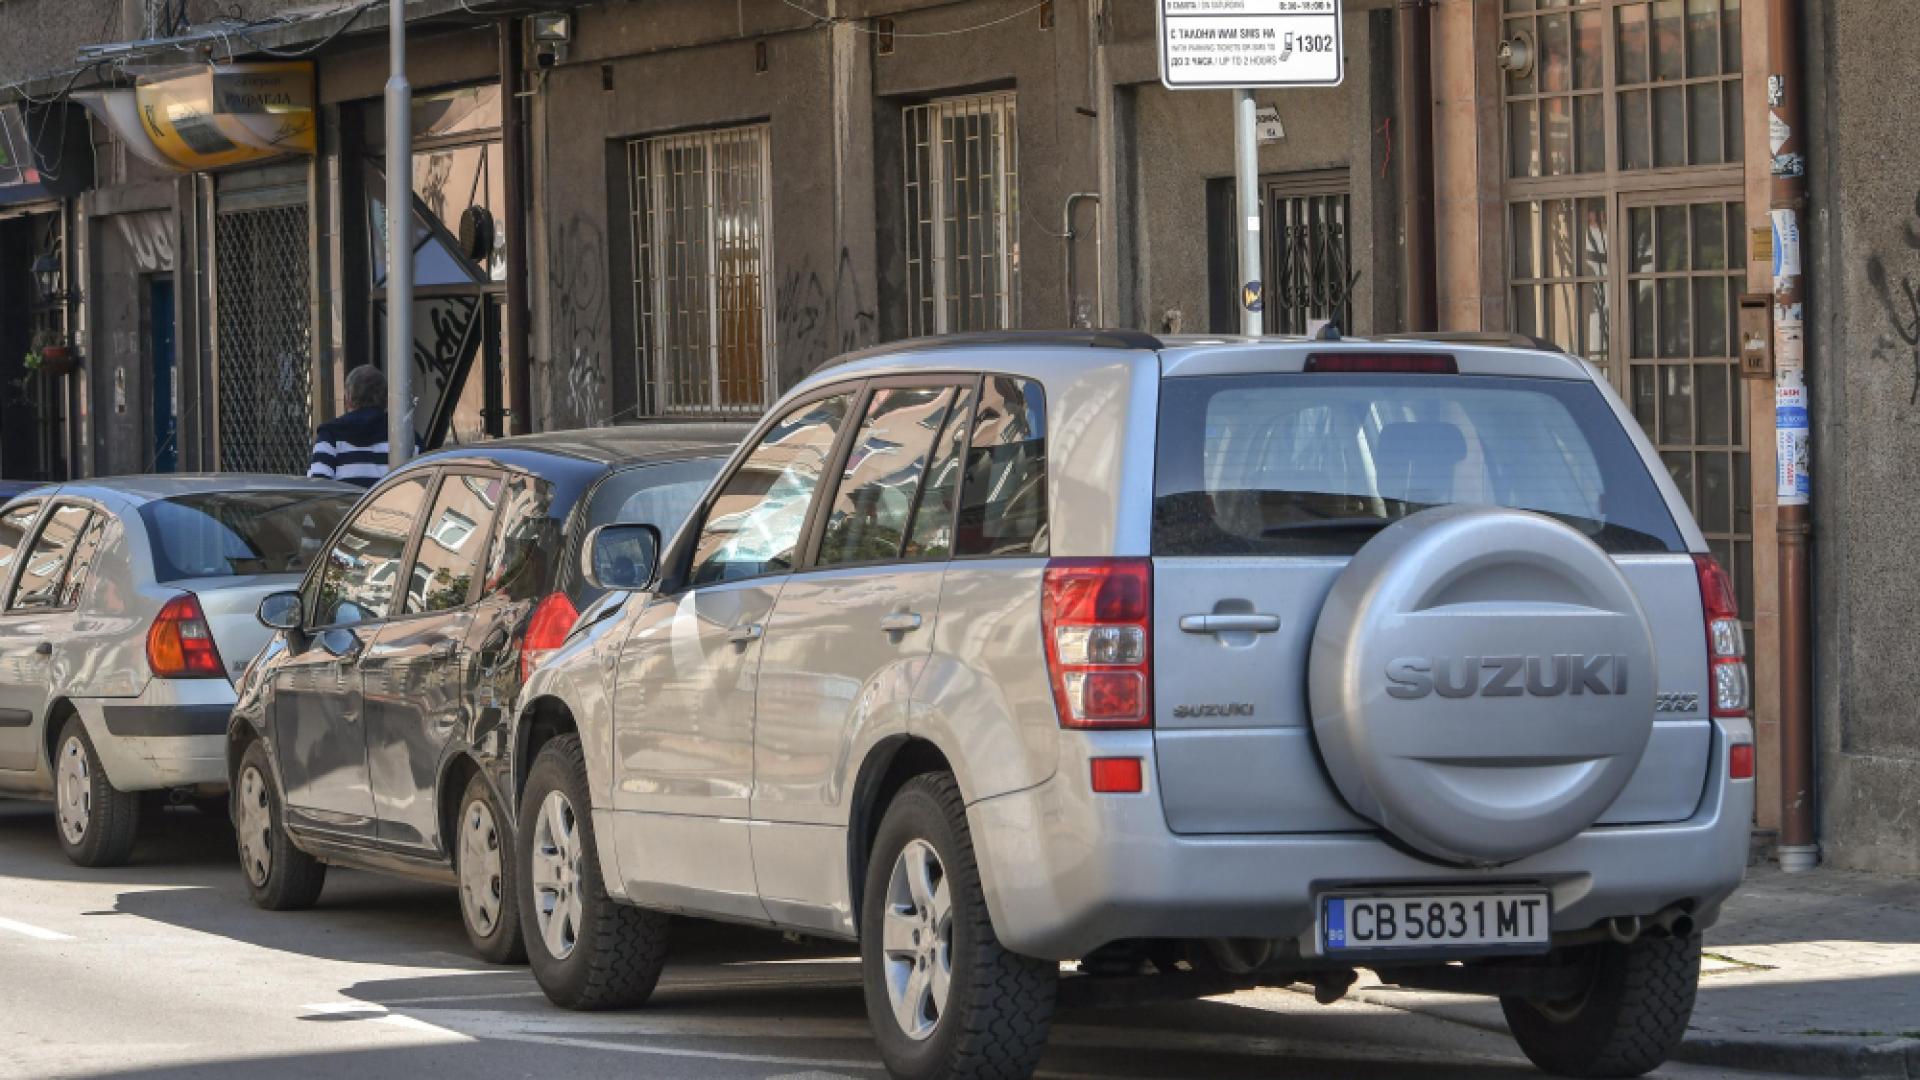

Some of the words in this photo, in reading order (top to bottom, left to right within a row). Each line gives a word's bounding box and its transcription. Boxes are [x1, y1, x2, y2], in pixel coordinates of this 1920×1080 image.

[1240, 28, 1260, 39] SMS
[1295, 34, 1333, 53] 1302
[1220, 57, 1231, 66] UP
[1233, 56, 1243, 66] TO
[1251, 55, 1279, 66] HOURS
[1384, 654, 1628, 700] SUZUKI
[1173, 703, 1255, 718] SUZUKI
